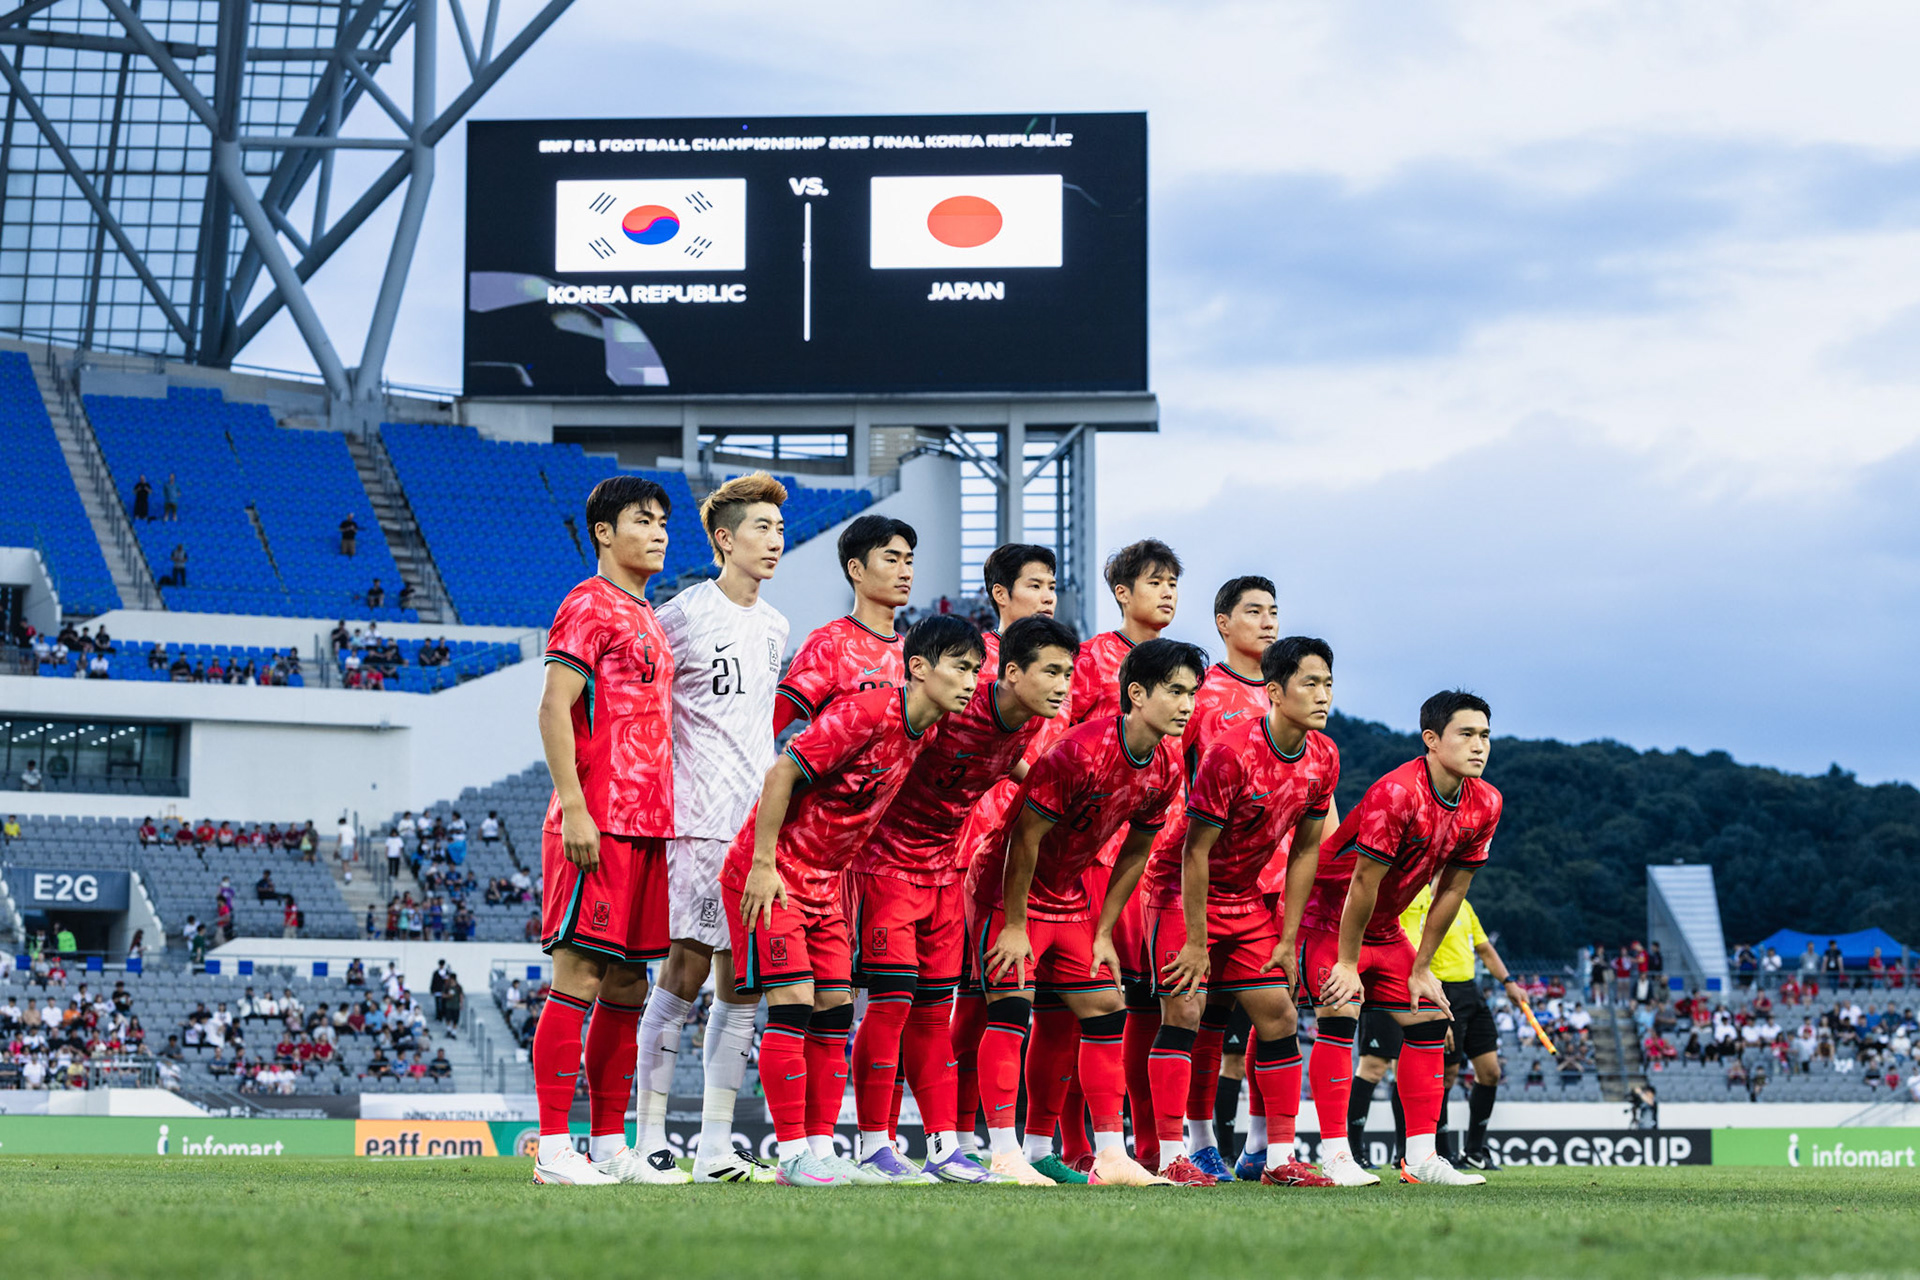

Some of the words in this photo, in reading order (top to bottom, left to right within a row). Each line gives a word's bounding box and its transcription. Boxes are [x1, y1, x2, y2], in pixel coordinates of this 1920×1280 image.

[599, 138, 691, 152] FOOTBALL
[691, 136, 827, 152] CHAMPIONSHIP
[828, 136, 871, 150] 2025
[873, 136, 924, 150] FINAL
[925, 135, 985, 149] KOREA
[986, 133, 1074, 148] REPUBLIC
[788, 176, 829, 196] VS.
[547, 285, 629, 304] KOREA
[631, 284, 747, 303] REPUBLIC
[927, 281, 1006, 301] JAPAN
[641, 645, 655, 683] 5
[712, 657, 745, 696] 21
[936, 764, 967, 789] 3
[1070, 803, 1100, 832] 6
[1243, 804, 1266, 832] 7
[34, 873, 98, 902] E2G
[182, 1135, 284, 1155] infomart
[365, 1132, 482, 1156] eaffcom
[1563, 1136, 1692, 1167] GROUP
[1812, 1142, 1916, 1168] infomart
